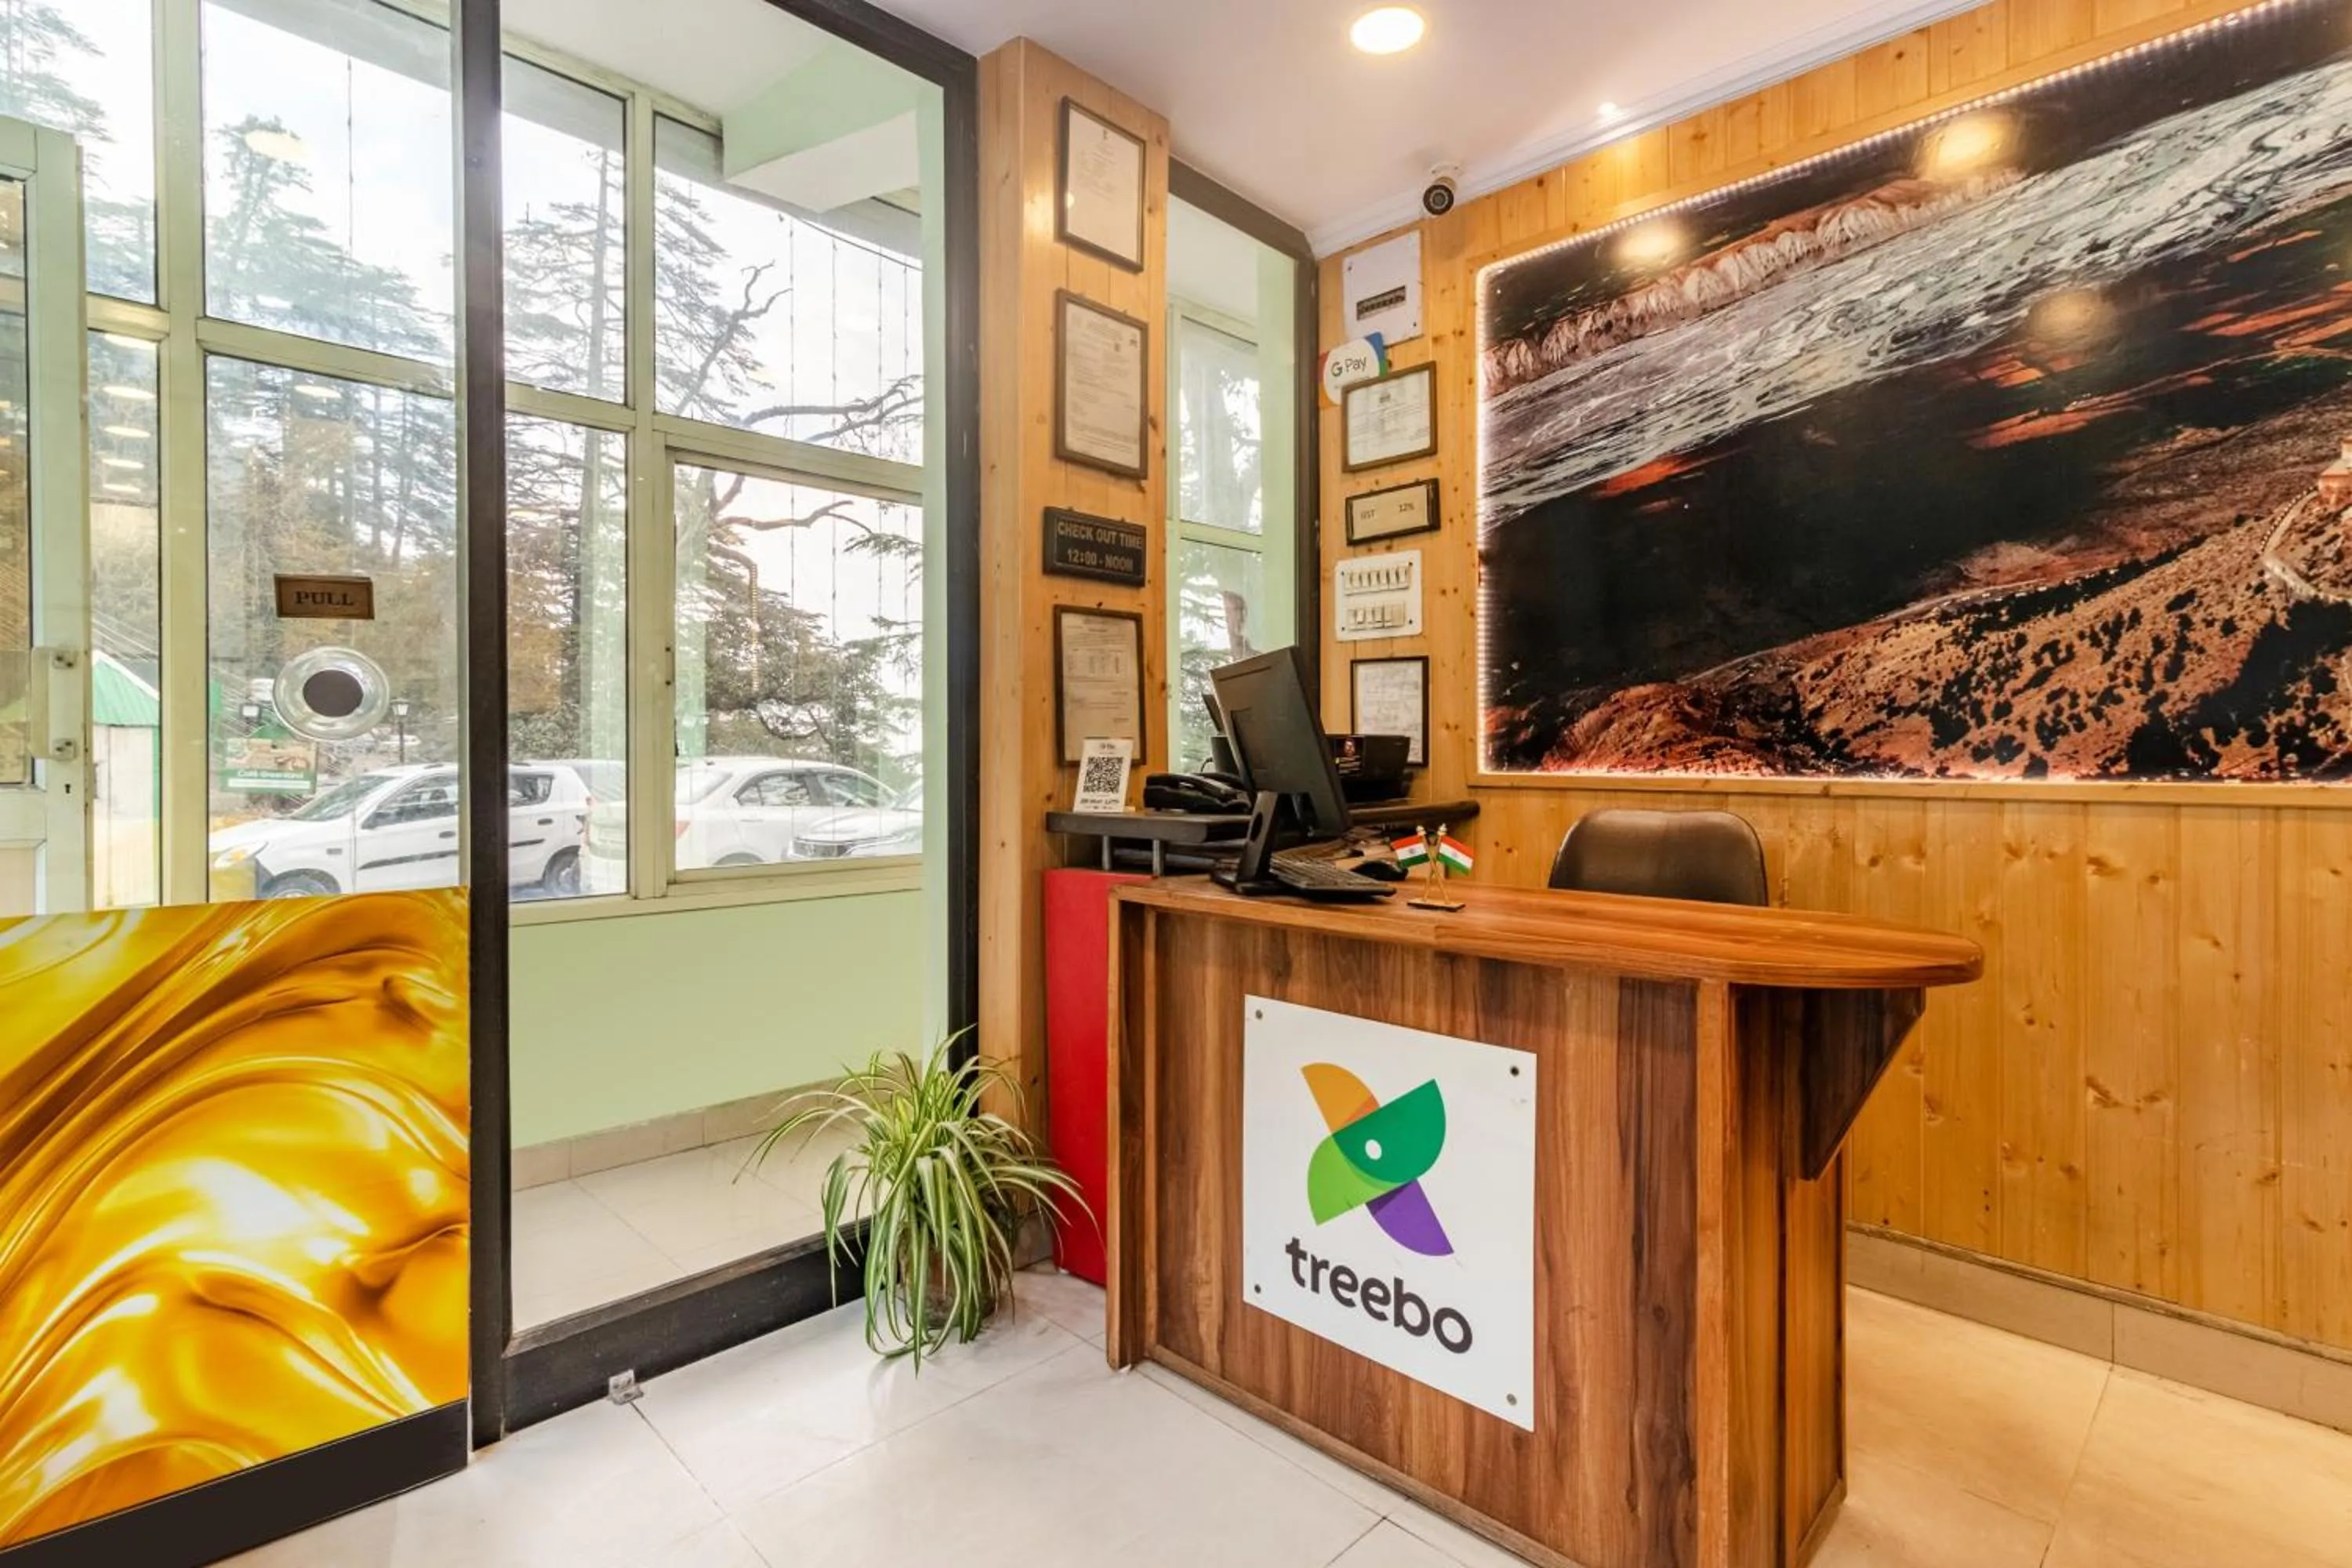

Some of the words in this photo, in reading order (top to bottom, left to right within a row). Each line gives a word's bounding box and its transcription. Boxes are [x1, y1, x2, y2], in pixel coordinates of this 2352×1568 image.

[1330, 361, 1343, 377] G
[1345, 357, 1367, 372] Pay
[1058, 521, 1094, 541] CHECK
[1096, 528, 1117, 544] OUT
[1120, 533, 1143, 549] TIME
[1105, 554, 1134, 572] NOON
[295, 590, 355, 607] PULL
[1284, 1236, 1473, 1355] treebo
